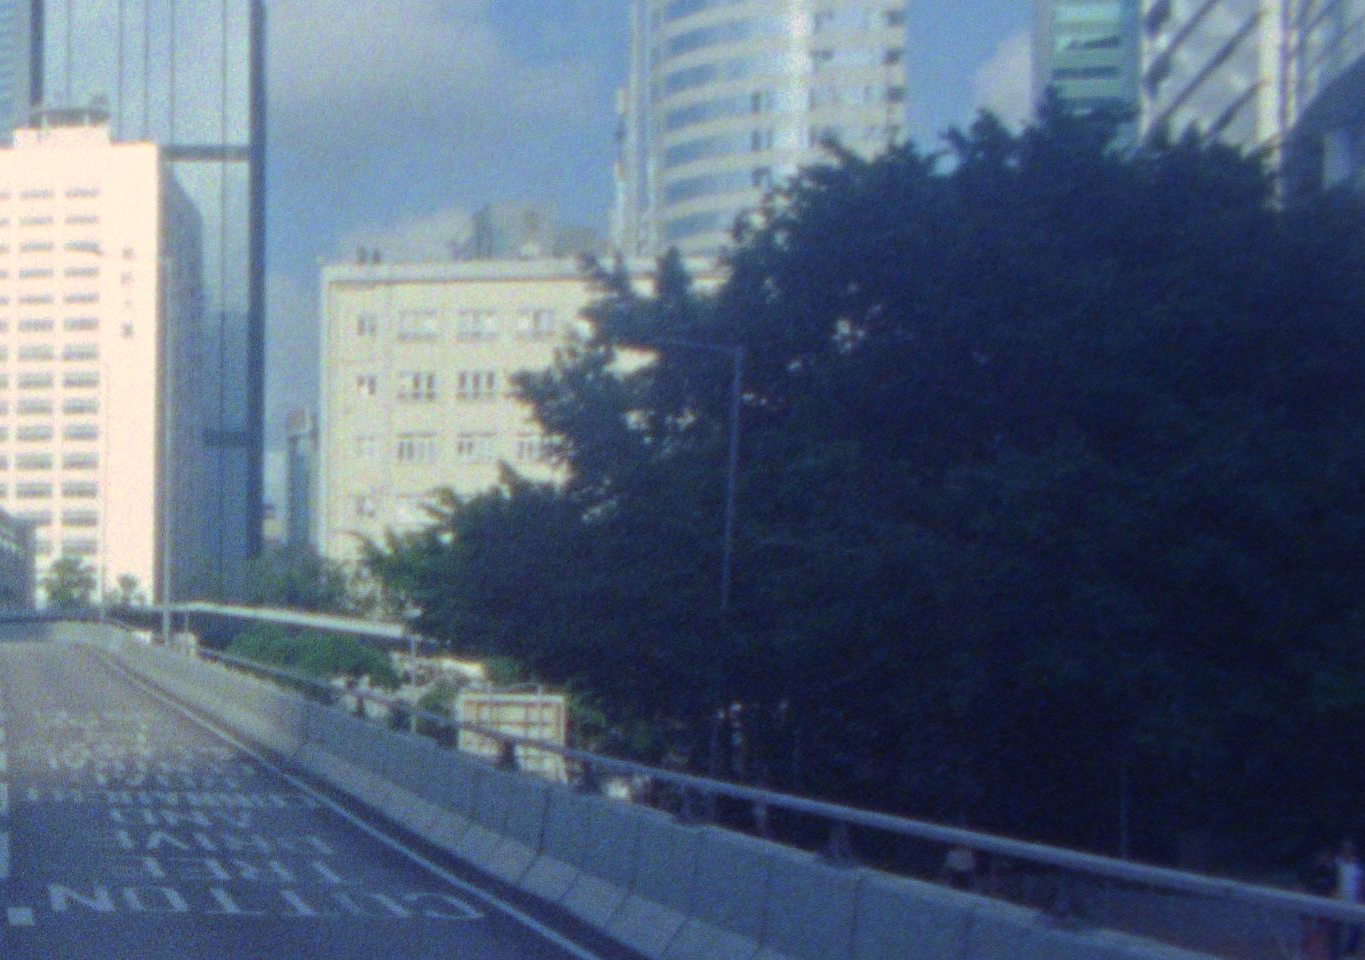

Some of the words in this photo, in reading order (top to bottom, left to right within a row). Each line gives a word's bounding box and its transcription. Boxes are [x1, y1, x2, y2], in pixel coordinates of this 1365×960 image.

[87, 829, 335, 855] DRIVE
[105, 856, 364, 885] TREE
[46, 883, 486, 920] COTTON
